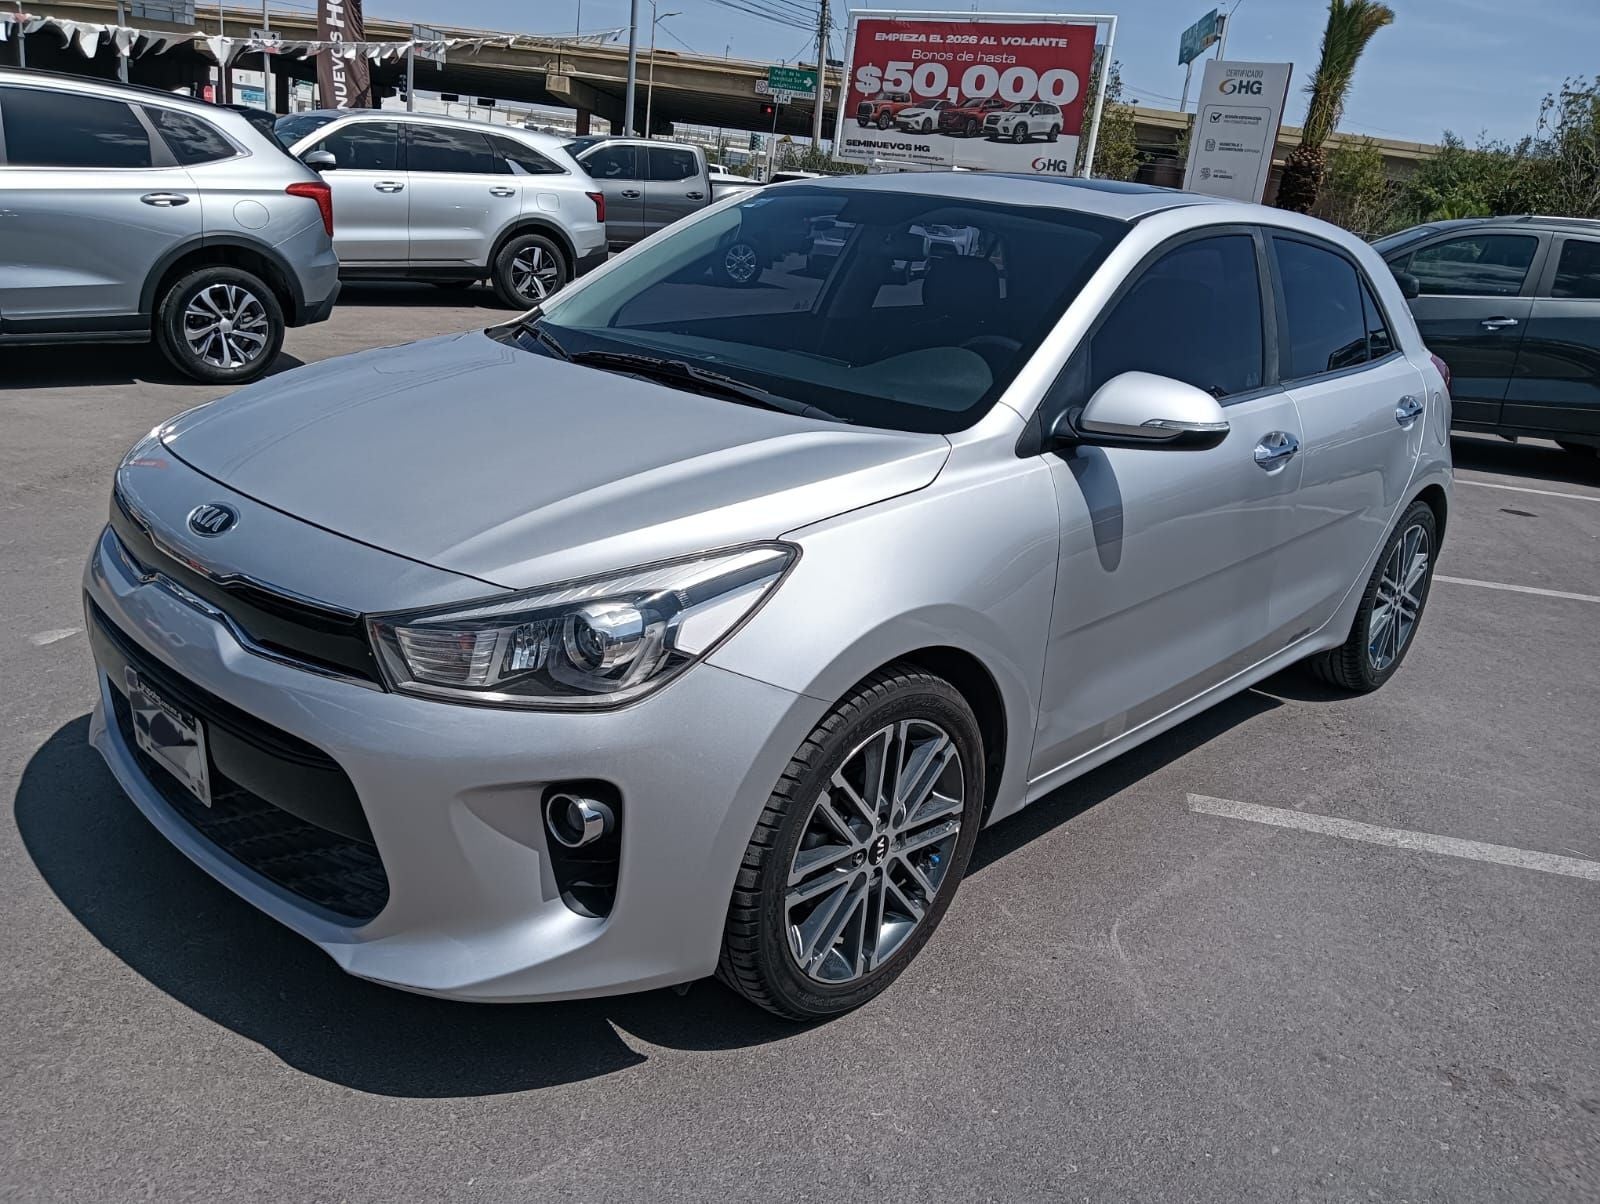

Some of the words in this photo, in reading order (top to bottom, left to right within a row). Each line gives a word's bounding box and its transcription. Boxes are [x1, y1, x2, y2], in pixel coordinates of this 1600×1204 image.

[874, 32, 926, 43] EMPIEZA
[929, 34, 943, 43] EL
[946, 35, 977, 44] 2026
[980, 36, 997, 45] AL
[1001, 37, 1067, 48] VOLANTE
[911, 49, 953, 61] Bonos
[956, 50, 974, 62] de
[977, 51, 1016, 63] hasta
[1226, 69, 1264, 79] CERTIFICADO
[855, 61, 1079, 106] $50,000
[1237, 79, 1263, 95] HG
[846, 139, 912, 151] SEMINUEVOS
[914, 144, 931, 153] HG
[1046, 158, 1067, 173] HG
[192, 506, 229, 532] KIA
[875, 836, 885, 865] KIA
